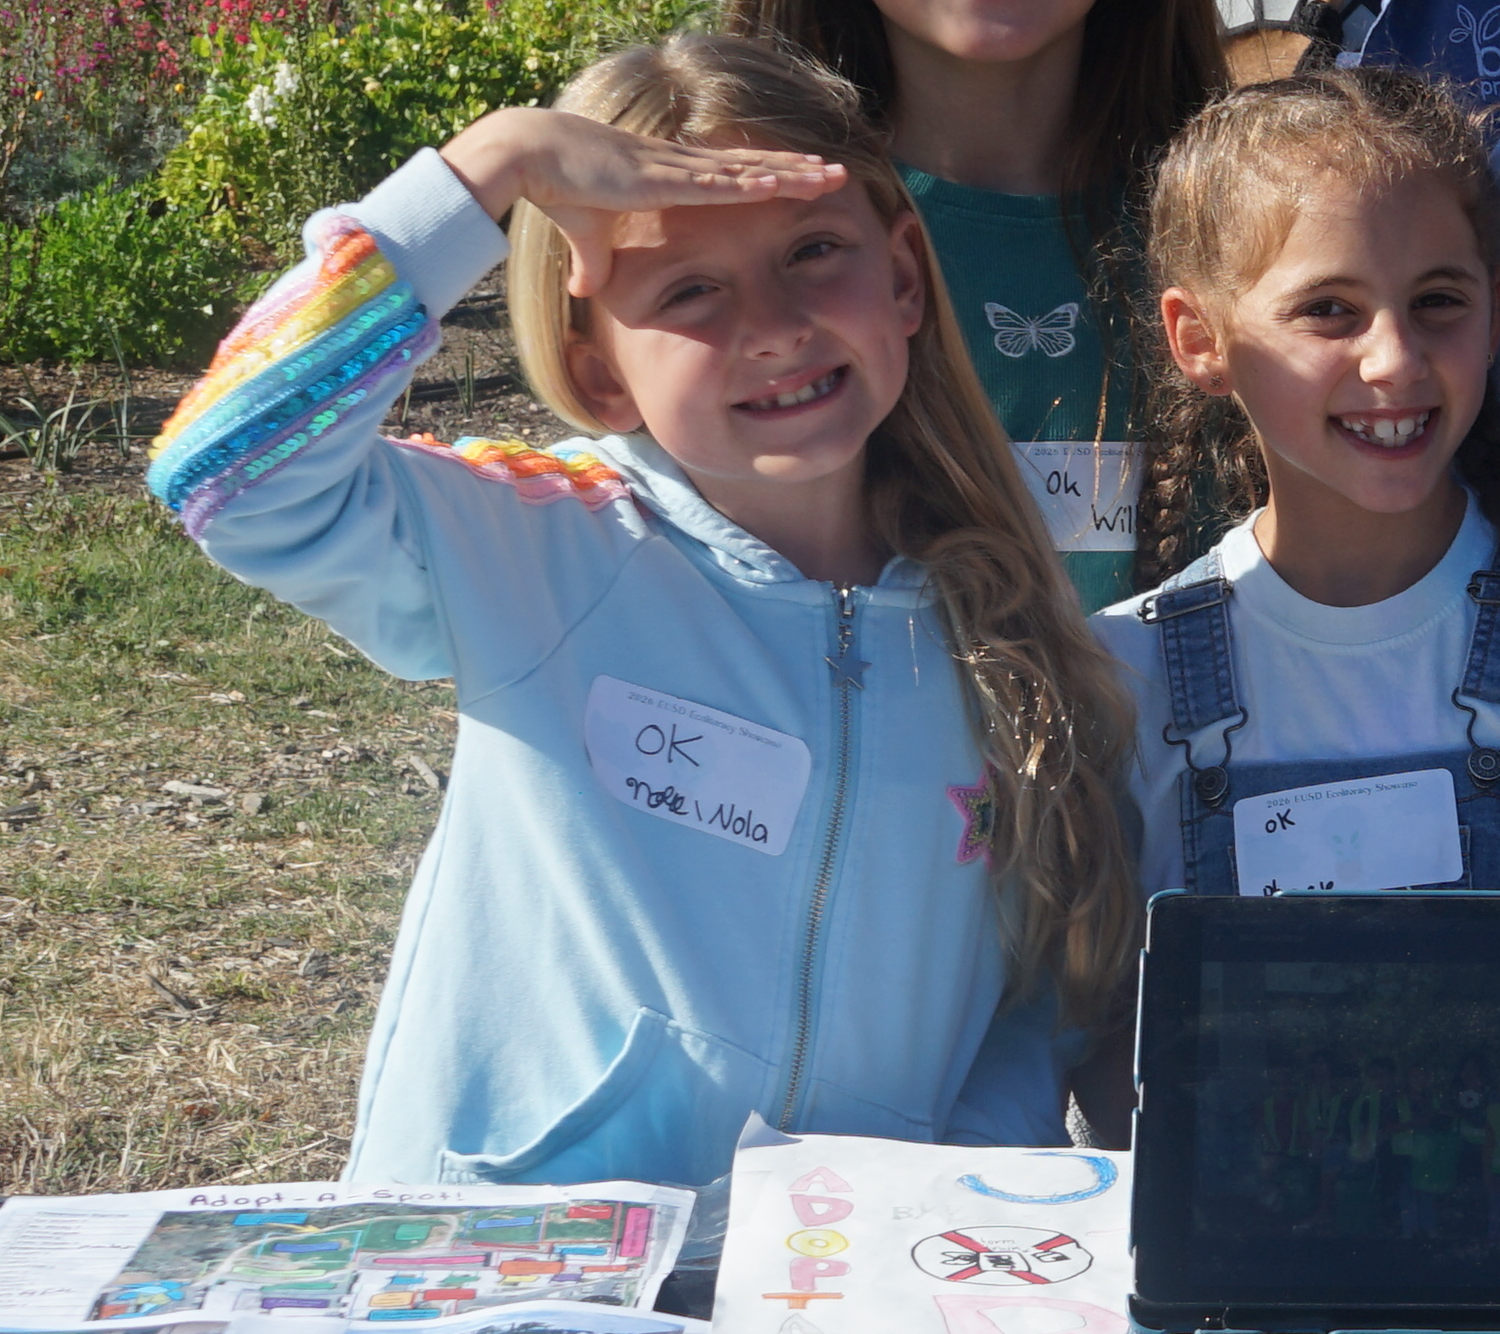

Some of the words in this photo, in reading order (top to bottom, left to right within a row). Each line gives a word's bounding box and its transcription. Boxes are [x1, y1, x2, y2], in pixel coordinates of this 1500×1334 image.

[636, 723, 704, 768] OK
[1266, 798, 1291, 809] 2026
[1293, 792, 1323, 804] EUSD
[1326, 786, 1372, 799] Ecoliteracy
[708, 803, 769, 844] Nola
